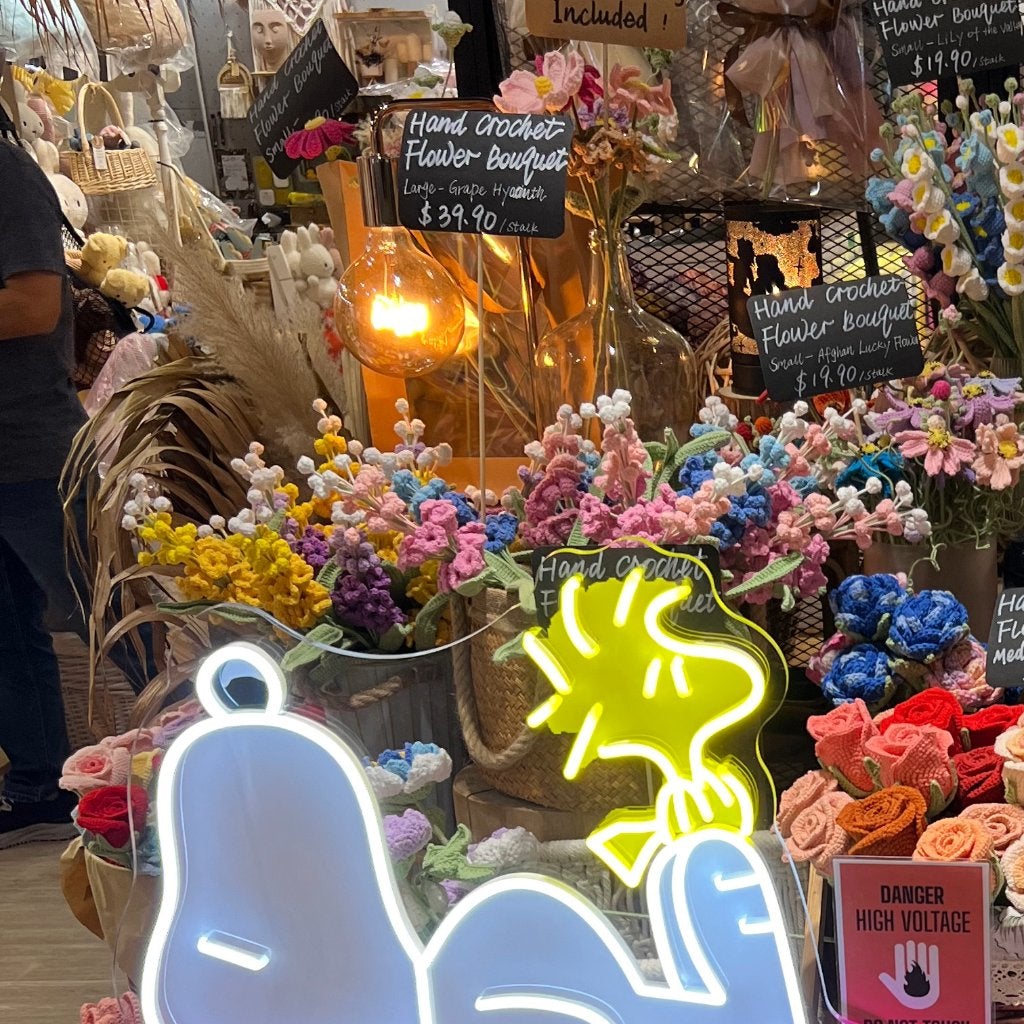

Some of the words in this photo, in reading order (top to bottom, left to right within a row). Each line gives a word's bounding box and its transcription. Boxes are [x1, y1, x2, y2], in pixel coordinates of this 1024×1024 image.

[553, 0, 647, 32] Included
[879, 14, 944, 40] Flower
[953, 0, 1017, 25] Bouquet
[968, 27, 980, 41] of
[983, 25, 998, 36] the
[250, 80, 278, 124] Hand
[253, 90, 290, 146] Flower
[410, 111, 468, 137] Hand
[475, 114, 565, 140] Crochet
[405, 139, 481, 170] Flower
[486, 144, 568, 185] Bouquet
[449, 180, 487, 202] Grape
[754, 289, 814, 320] Hand
[761, 318, 834, 354] Flower
[843, 301, 913, 338] Bouquet
[818, 345, 854, 363] Afghan
[859, 341, 890, 358] Lucky
[539, 550, 606, 581] Hand
[881, 885, 944, 904] DANGER
[856, 909, 894, 931] HIGH
[901, 911, 971, 933] VOLTAGE
